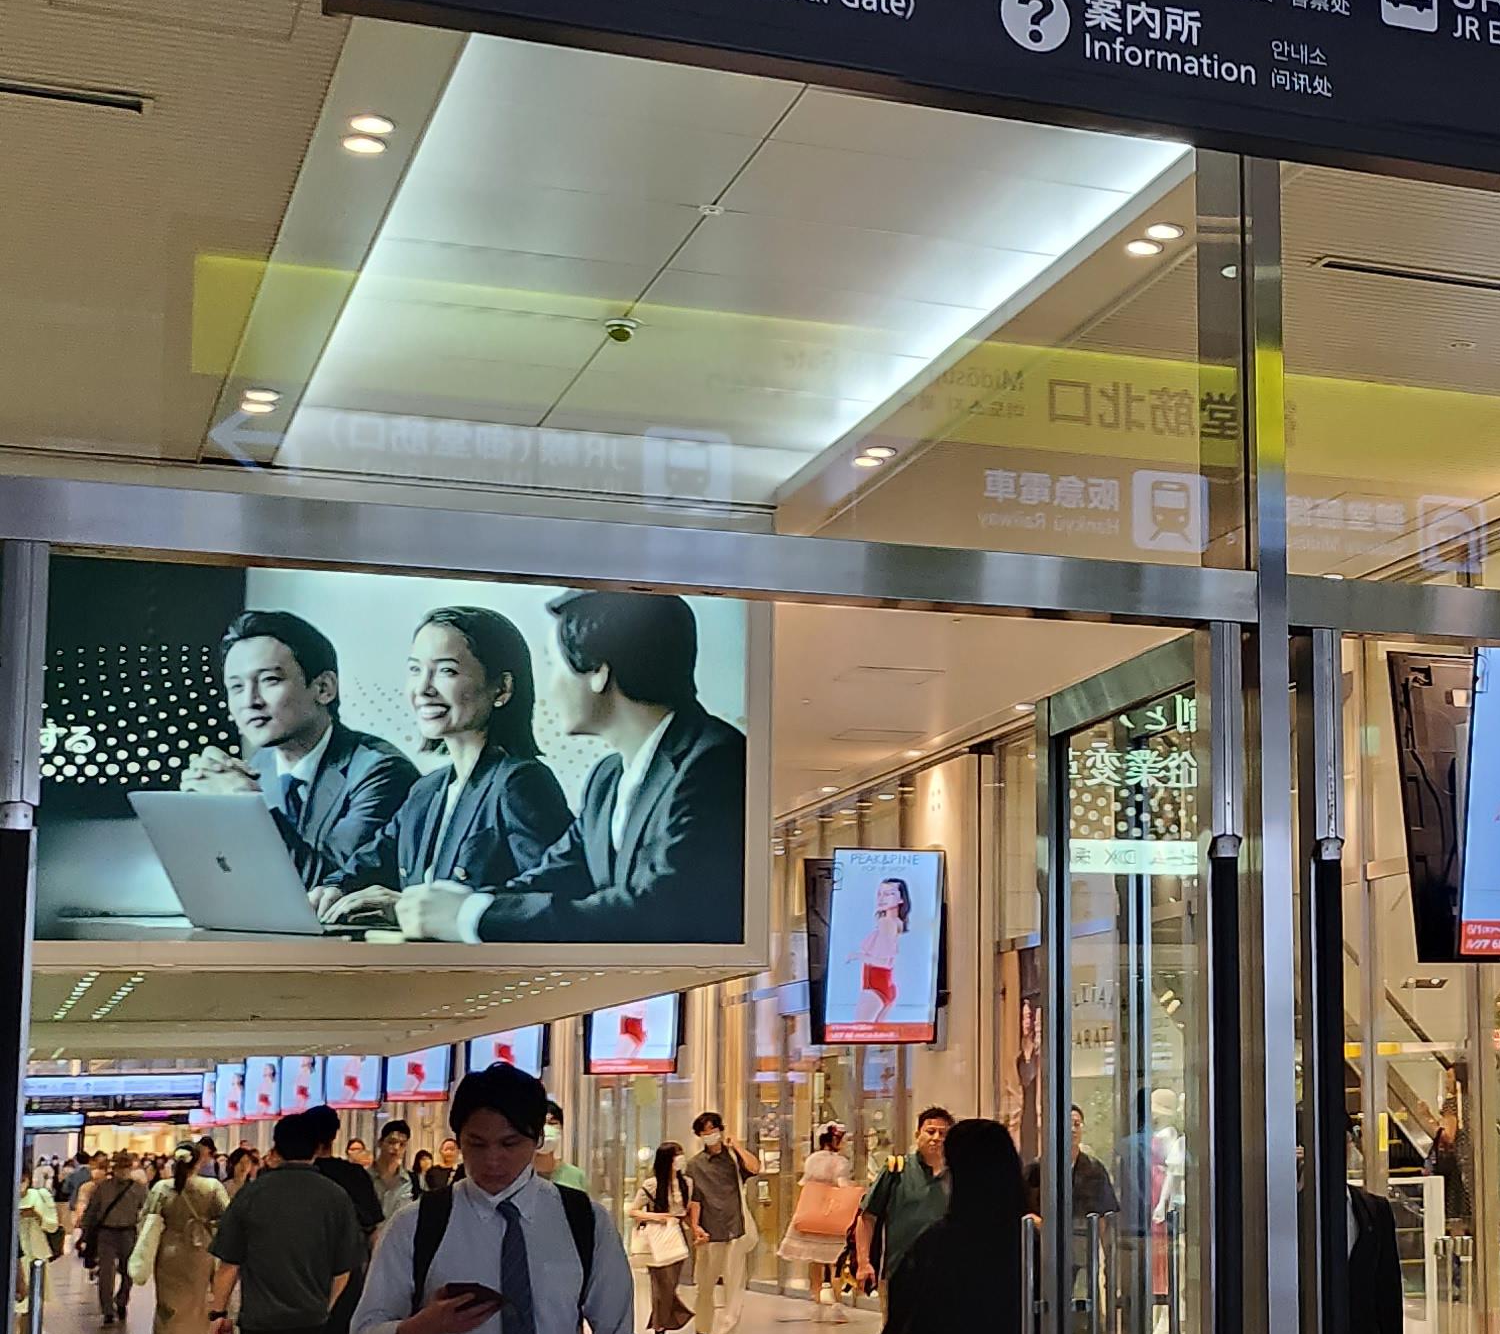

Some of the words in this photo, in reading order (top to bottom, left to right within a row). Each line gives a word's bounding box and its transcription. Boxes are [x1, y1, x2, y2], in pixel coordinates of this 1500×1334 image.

[1453, 14, 1481, 41] JR
[1084, 33, 1257, 85] Information
[1271, 39, 1328, 66] 안내소
[1271, 68, 1334, 98] 问讯处
